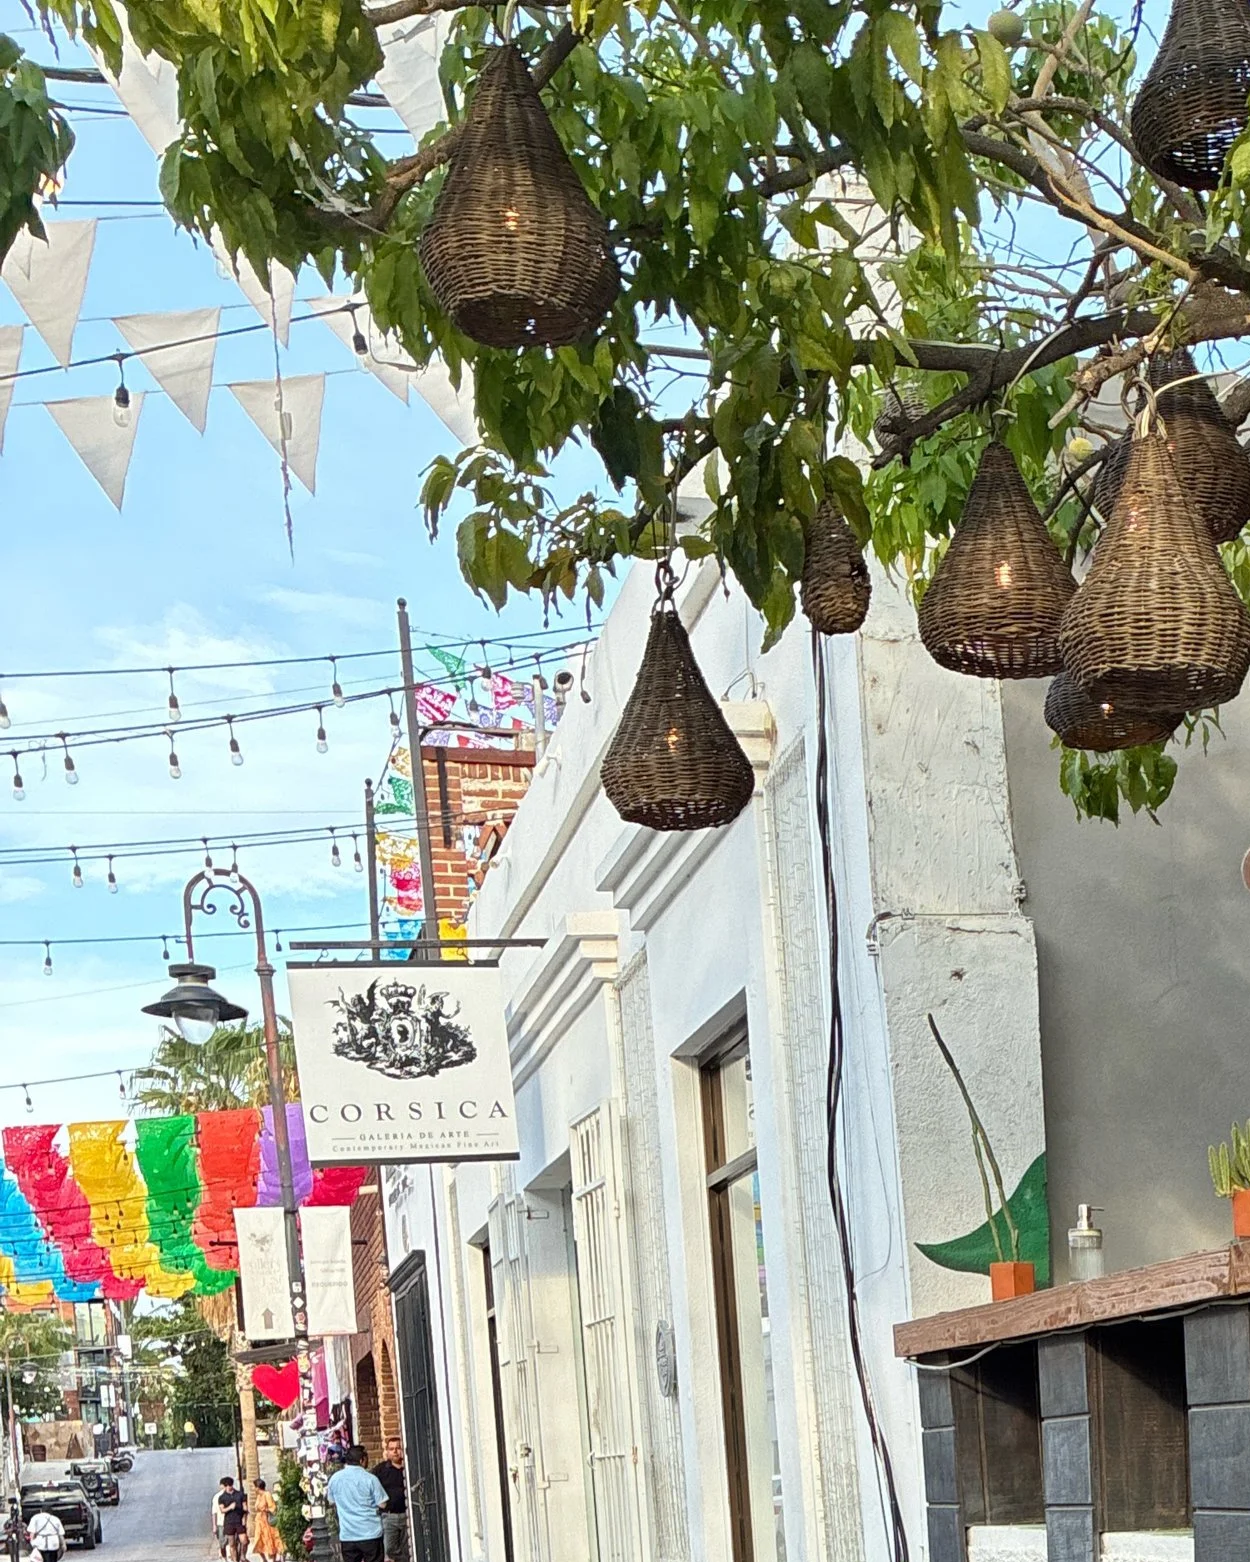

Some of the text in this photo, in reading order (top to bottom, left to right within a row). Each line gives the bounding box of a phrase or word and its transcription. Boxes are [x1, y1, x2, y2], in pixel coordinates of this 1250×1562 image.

[309, 1099, 509, 1124] CORSICA
[419, 1131, 434, 1140] DE
[439, 1130, 470, 1139] ARTE
[332, 1144, 404, 1152] Contemporary
[456, 1141, 479, 1149] Fine
[484, 1140, 500, 1148] Art
